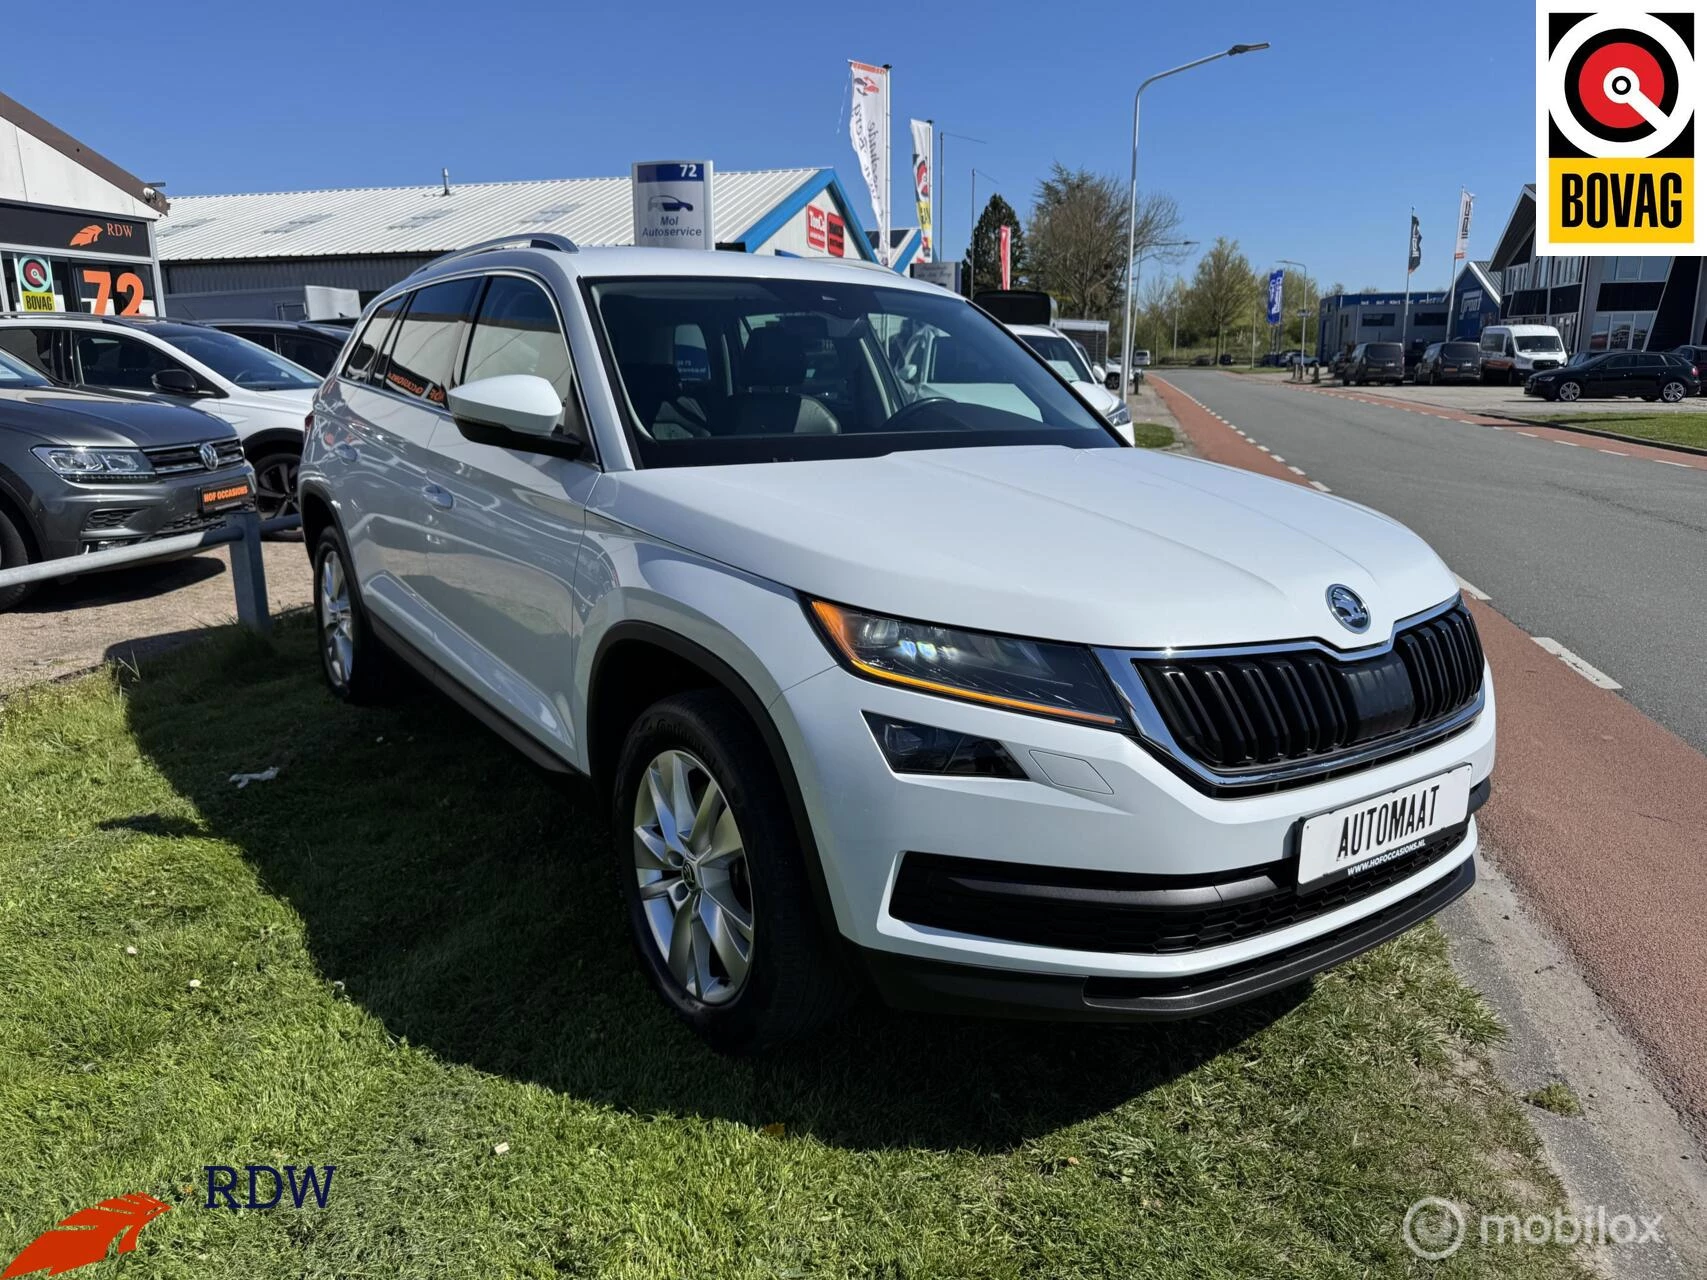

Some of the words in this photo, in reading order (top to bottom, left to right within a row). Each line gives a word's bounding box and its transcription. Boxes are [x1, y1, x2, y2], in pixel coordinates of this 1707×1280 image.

[680, 164, 697, 177] 72
[660, 216, 679, 225] Mol
[107, 223, 133, 238] RDW
[642, 227, 702, 238] Autoservice
[83, 270, 144, 316] 72
[25, 294, 53, 311] BOVAG
[203, 491, 216, 503] HOF
[217, 485, 248, 499] OCCASIONS
[1336, 784, 1440, 862] AUTOMAAT
[1346, 838, 1427, 877] WWW.HOFOCCASIONS.NL
